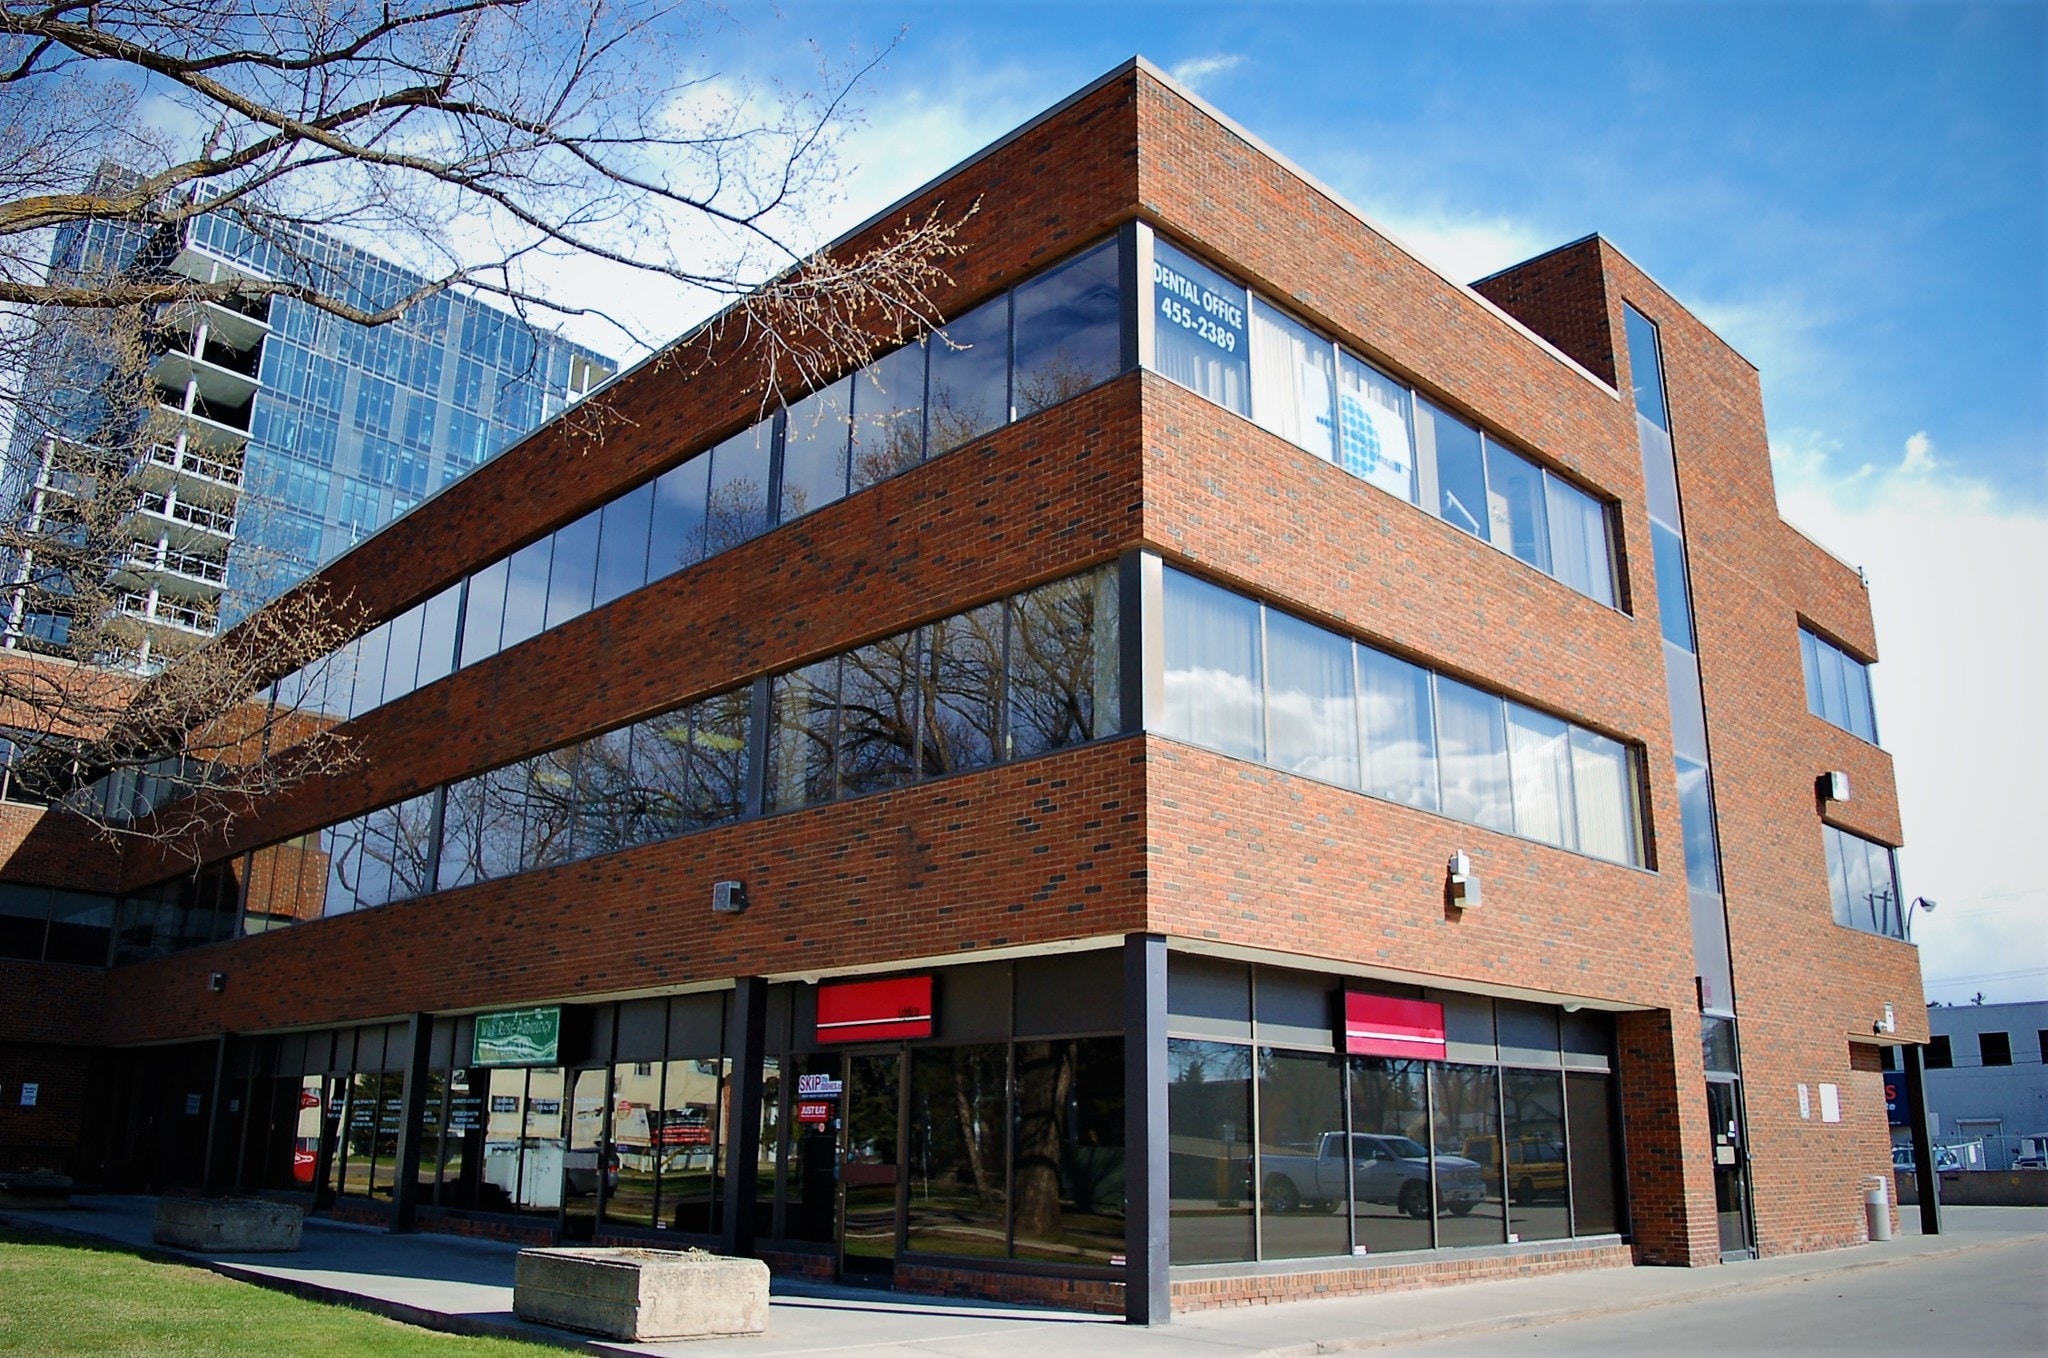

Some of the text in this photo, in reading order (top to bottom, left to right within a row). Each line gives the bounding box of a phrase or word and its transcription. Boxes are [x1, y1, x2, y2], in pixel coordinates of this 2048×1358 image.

[1154, 261, 1242, 330] DENTAL OFFICE
[1161, 297, 1236, 353] 455-2389
[800, 1076, 821, 1091] SKIP
